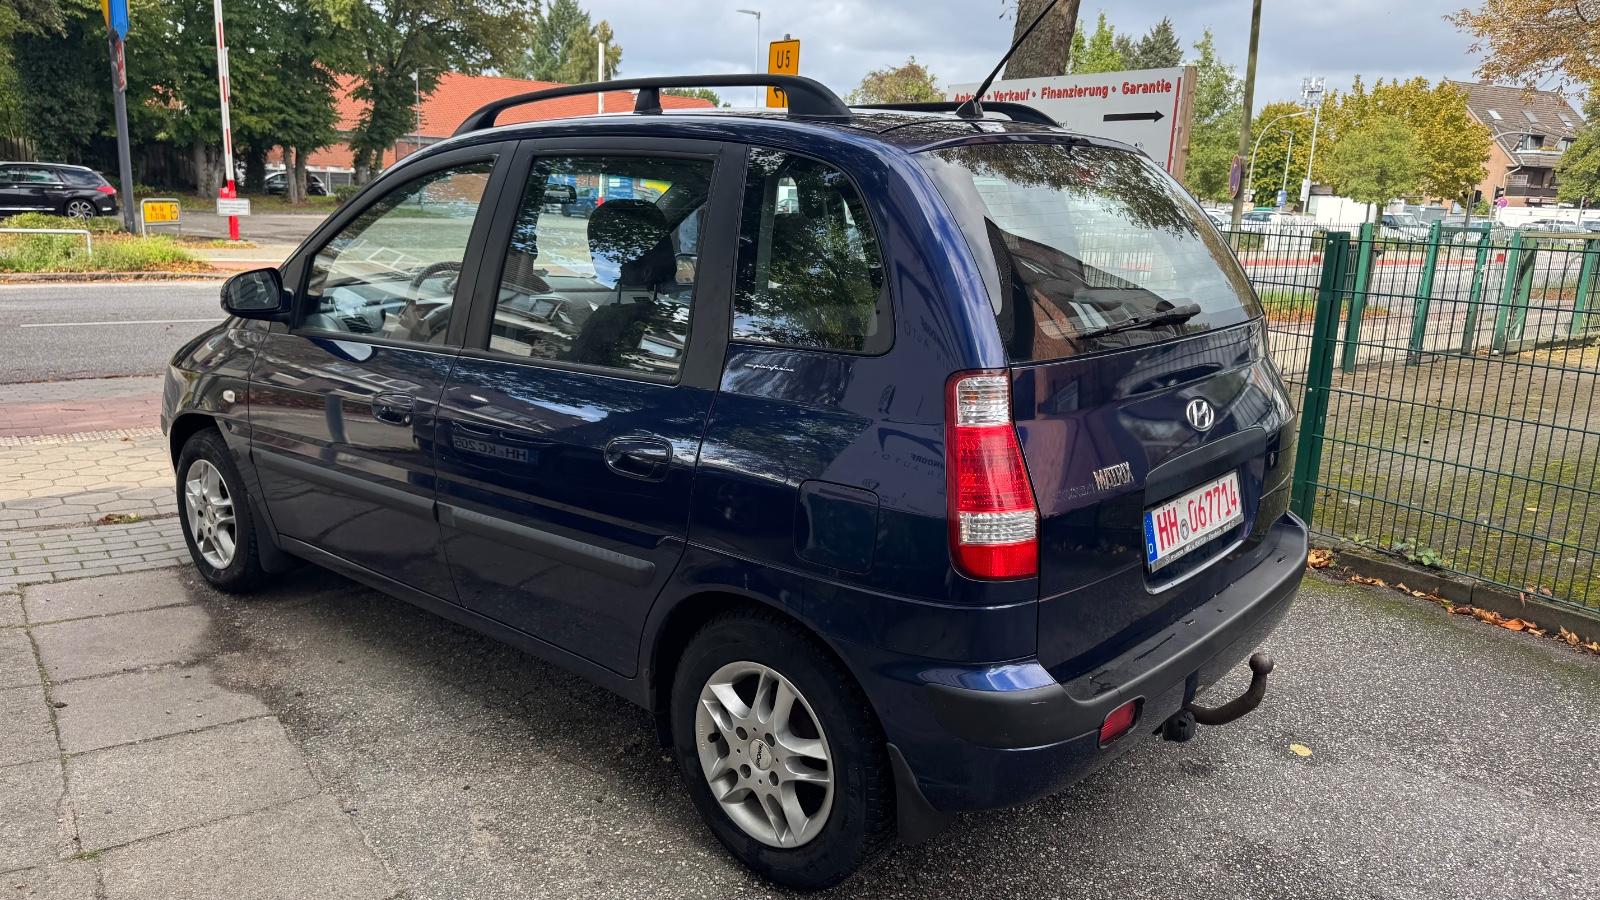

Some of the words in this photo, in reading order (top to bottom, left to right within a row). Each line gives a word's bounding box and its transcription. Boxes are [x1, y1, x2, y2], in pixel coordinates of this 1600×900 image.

[993, 88, 1030, 101] Verkauf
[1041, 84, 1109, 100] Finanzierung
[1121, 78, 1172, 95] Garantie
[1156, 506, 1181, 552] HH
[1187, 479, 1238, 533] 067714
